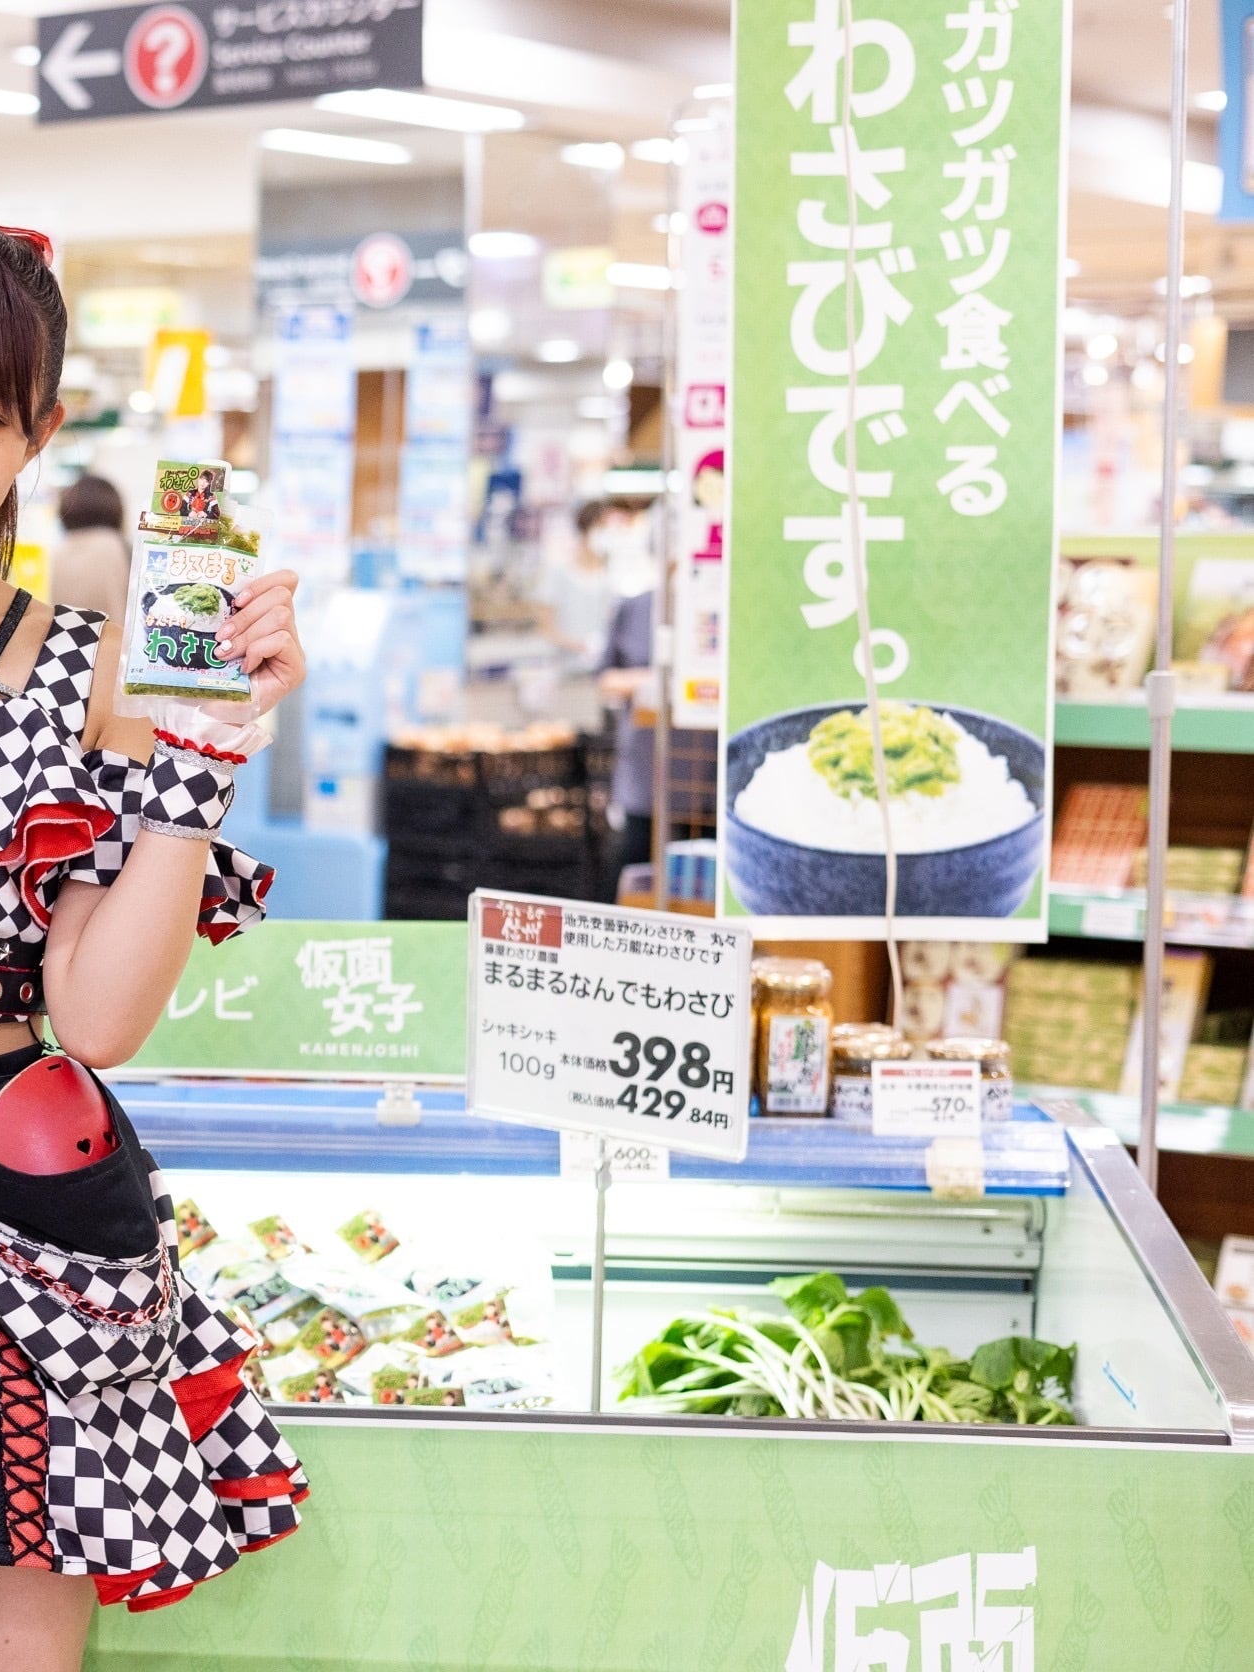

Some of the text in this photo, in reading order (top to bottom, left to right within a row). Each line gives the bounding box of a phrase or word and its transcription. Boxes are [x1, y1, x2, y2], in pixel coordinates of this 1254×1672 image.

[934, 0, 1019, 517] ガツガツ食べる
[782, 0, 917, 684] わさびです。
[170, 549, 236, 586] まるまる
[295, 936, 394, 988] 仮面
[563, 932, 724, 964] 使用した万能なわさびです
[322, 983, 424, 1037] 女子
[484, 960, 734, 1019] まるまるなんでもわさび
[300, 1042, 421, 1058] KAMENJOSHI
[481, 1018, 558, 1043] シャキシャキ
[499, 1051, 556, 1080] 100g
